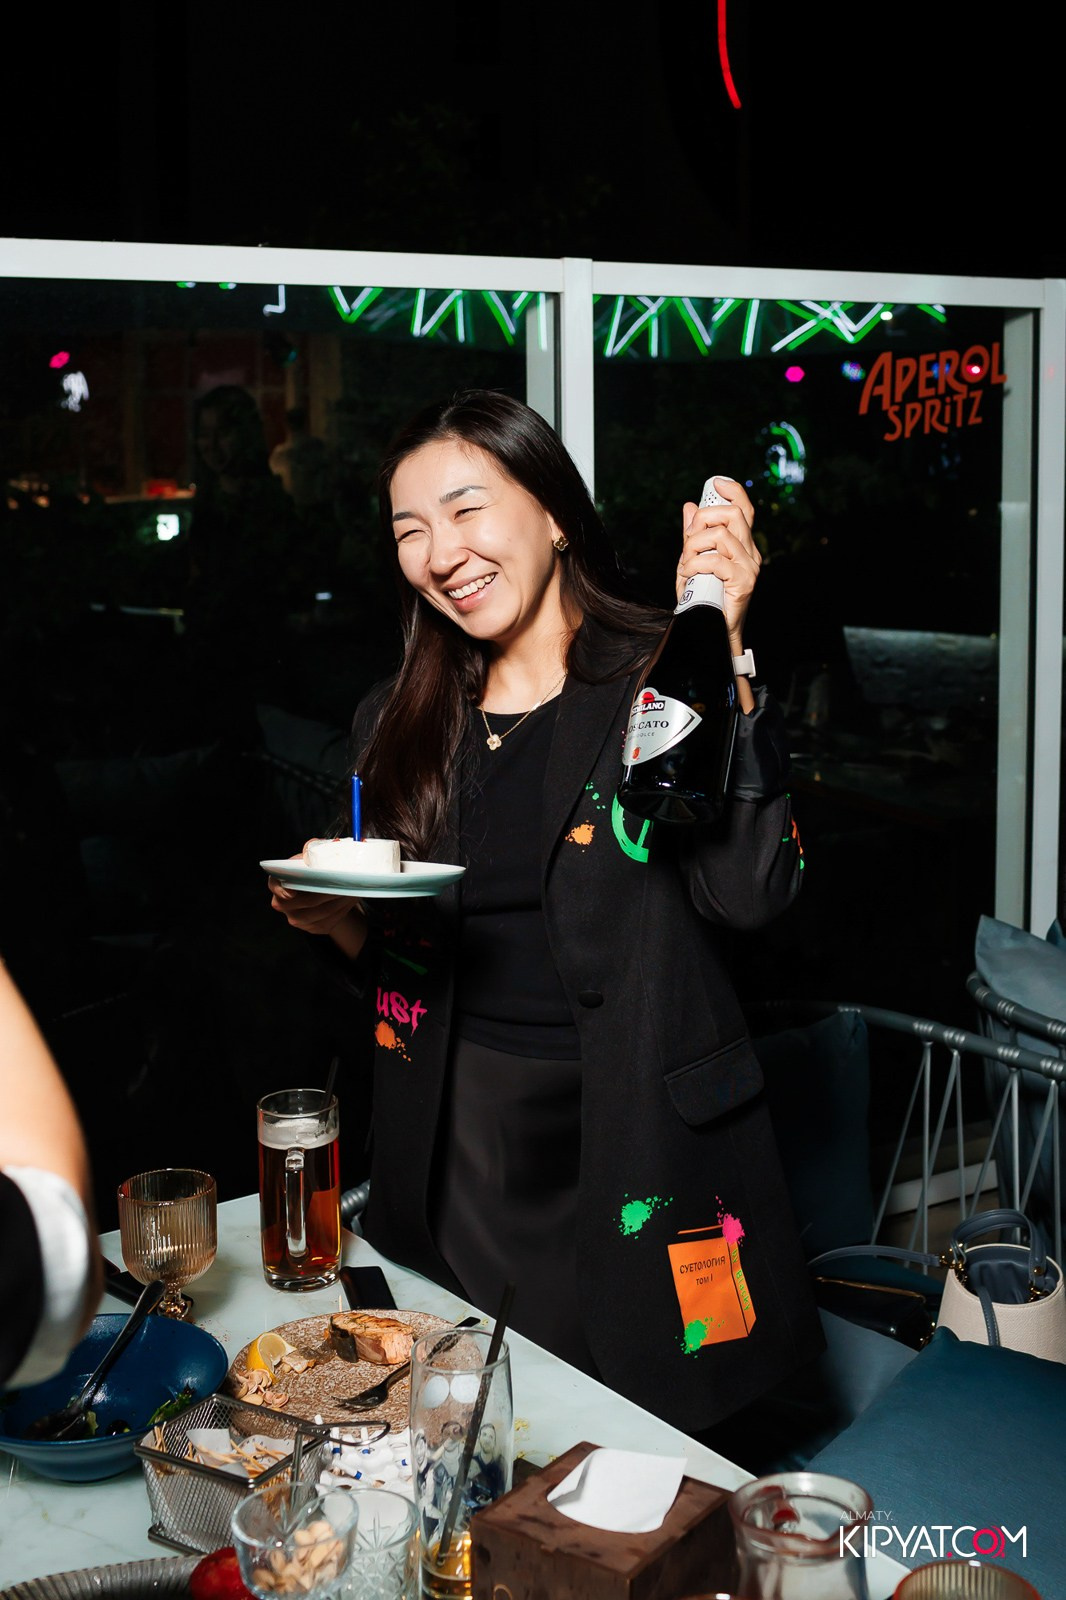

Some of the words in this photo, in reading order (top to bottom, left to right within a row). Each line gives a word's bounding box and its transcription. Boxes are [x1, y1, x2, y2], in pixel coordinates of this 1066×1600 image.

[859, 342, 1007, 415] APEROL
[628, 720, 669, 733] OSCATO
[680, 1256, 726, 1274] СУЕТОЛОГИЯ
